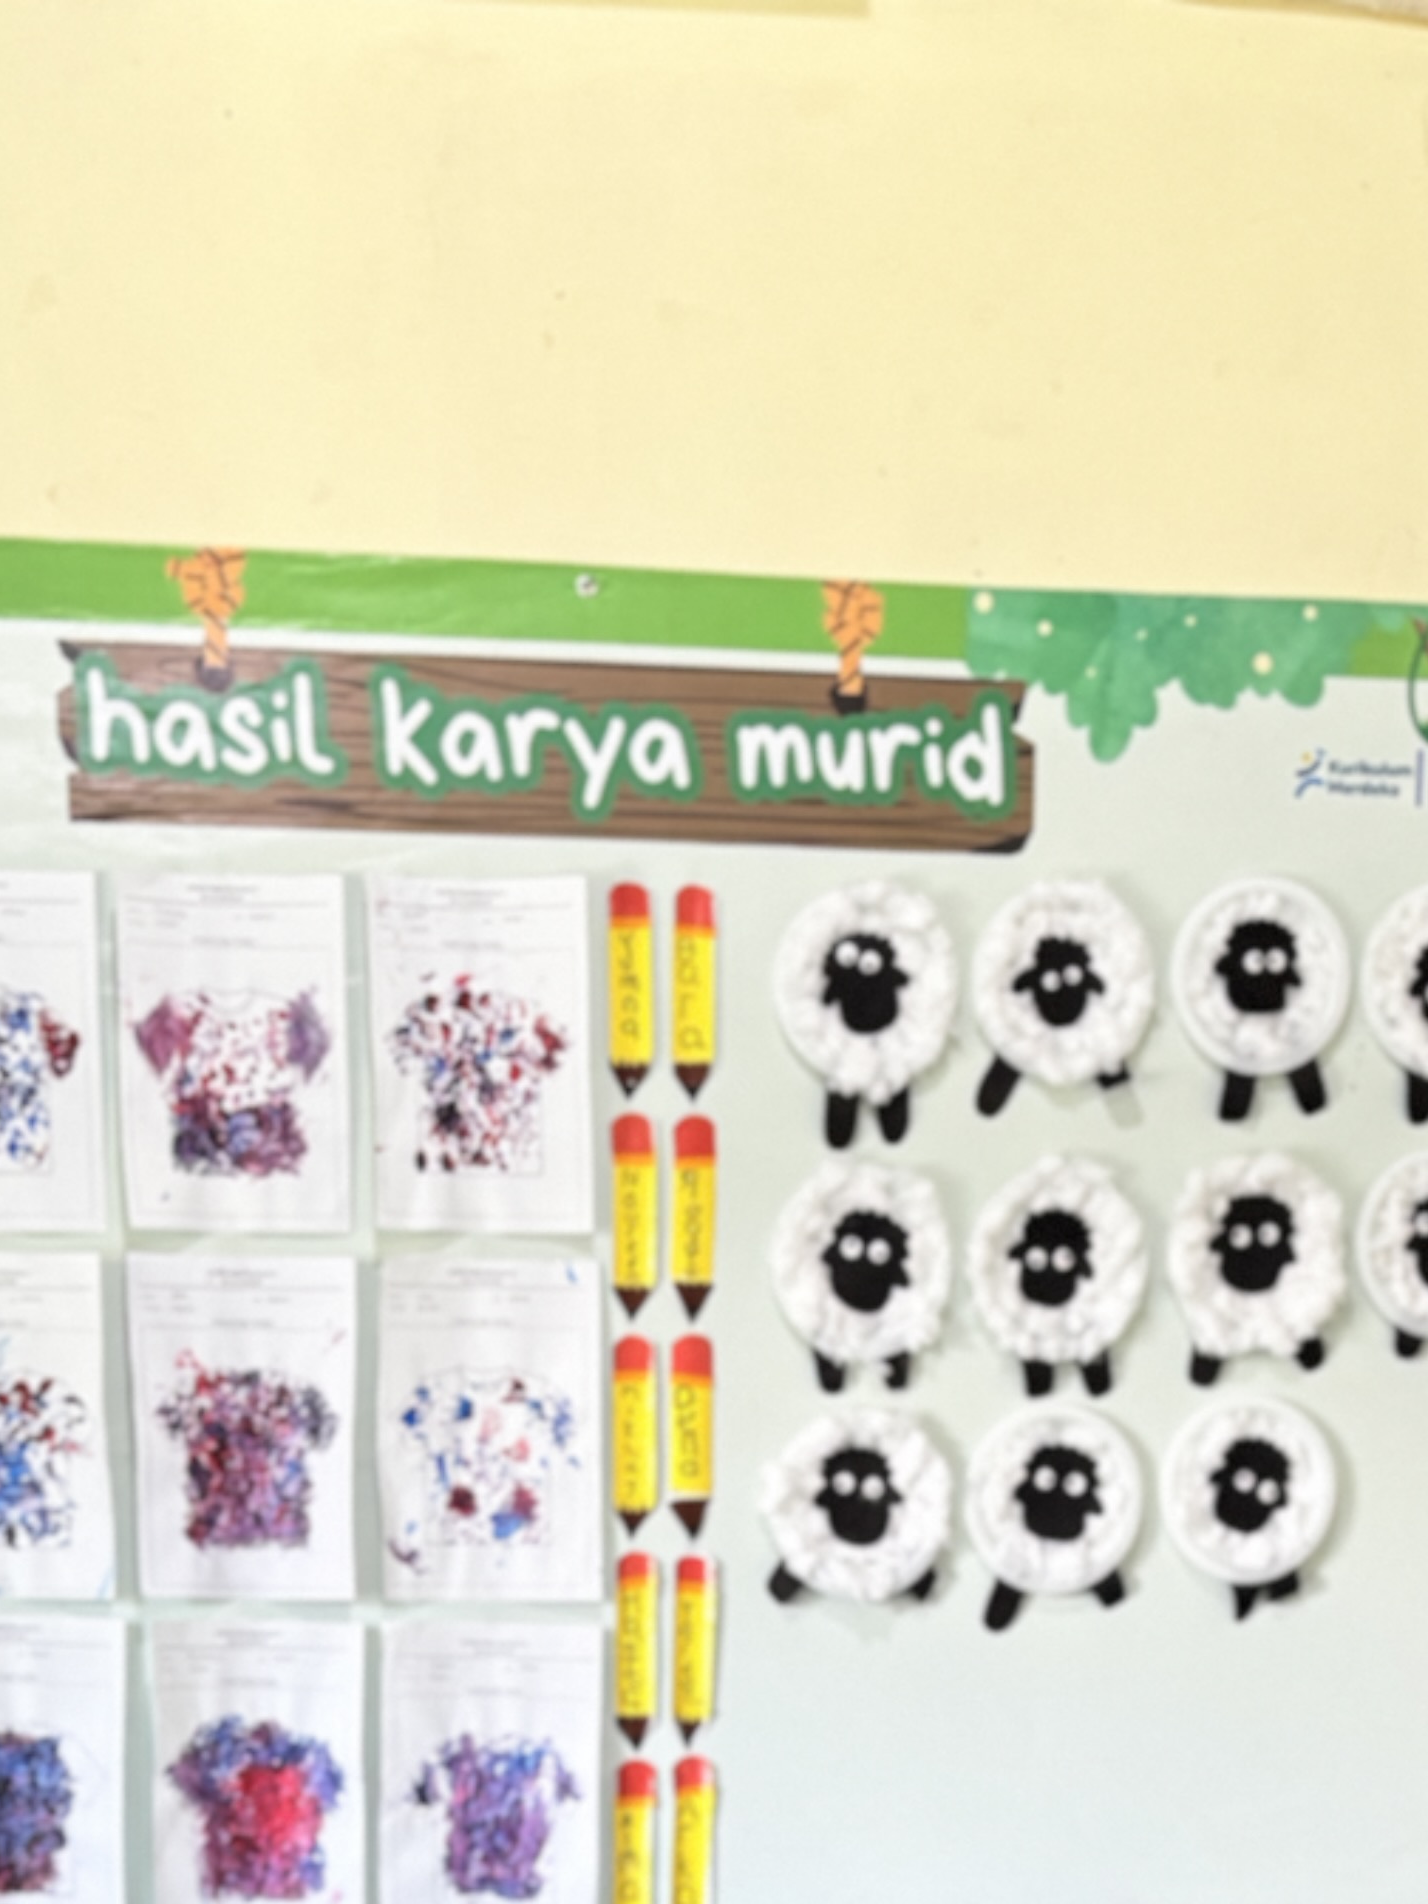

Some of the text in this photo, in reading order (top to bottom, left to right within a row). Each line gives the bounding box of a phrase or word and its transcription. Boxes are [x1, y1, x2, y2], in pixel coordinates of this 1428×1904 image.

[85, 667, 1007, 810] hasil karya murid
